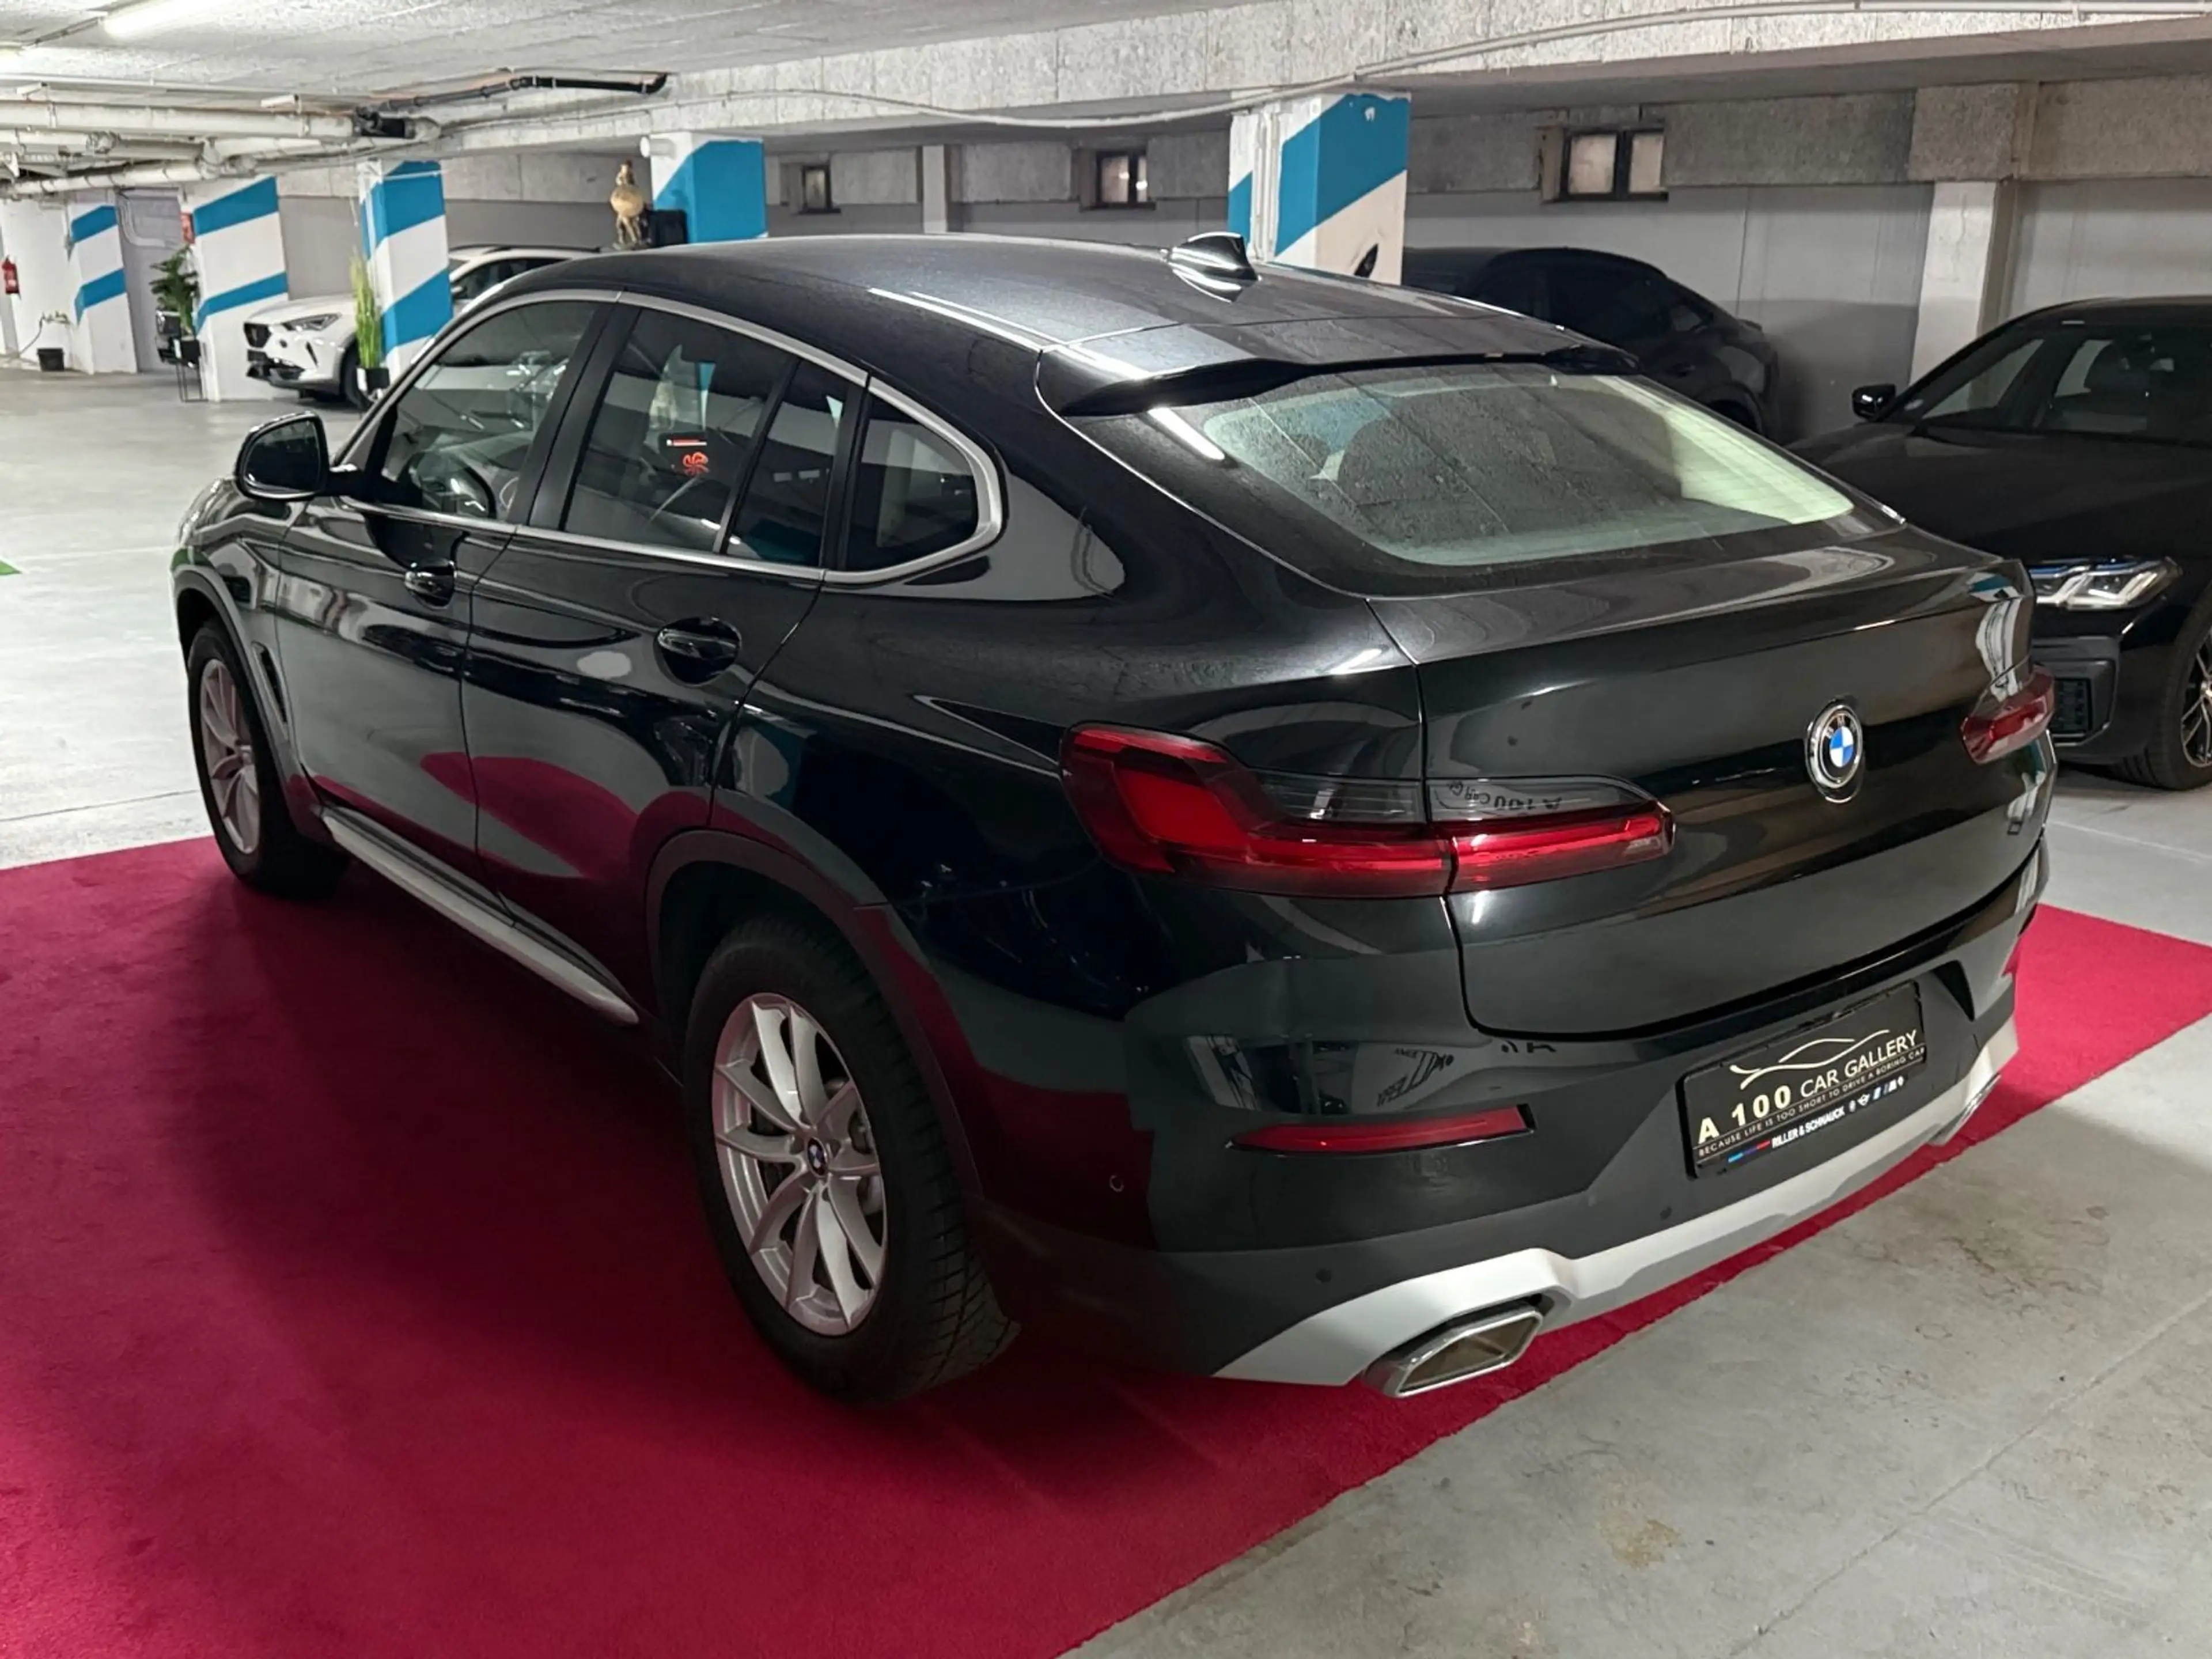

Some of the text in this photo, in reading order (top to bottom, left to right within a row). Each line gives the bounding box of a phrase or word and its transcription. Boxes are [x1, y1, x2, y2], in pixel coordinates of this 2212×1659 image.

[1698, 1029, 1917, 1145] A 100 CAR GALLERY
[1699, 1132, 1741, 1157] BECAUSE
[1744, 1123, 1763, 1137] LIFE
[1765, 1118, 1774, 1128] IS
[1776, 1108, 1796, 1122] TOO
[1798, 1094, 1827, 1112] SHORT
[1829, 1089, 1840, 1098] TO
[1843, 1075, 1866, 1092] DRIVE
[1868, 1072, 1874, 1080] A
[1876, 1056, 1906, 1075] BORING
